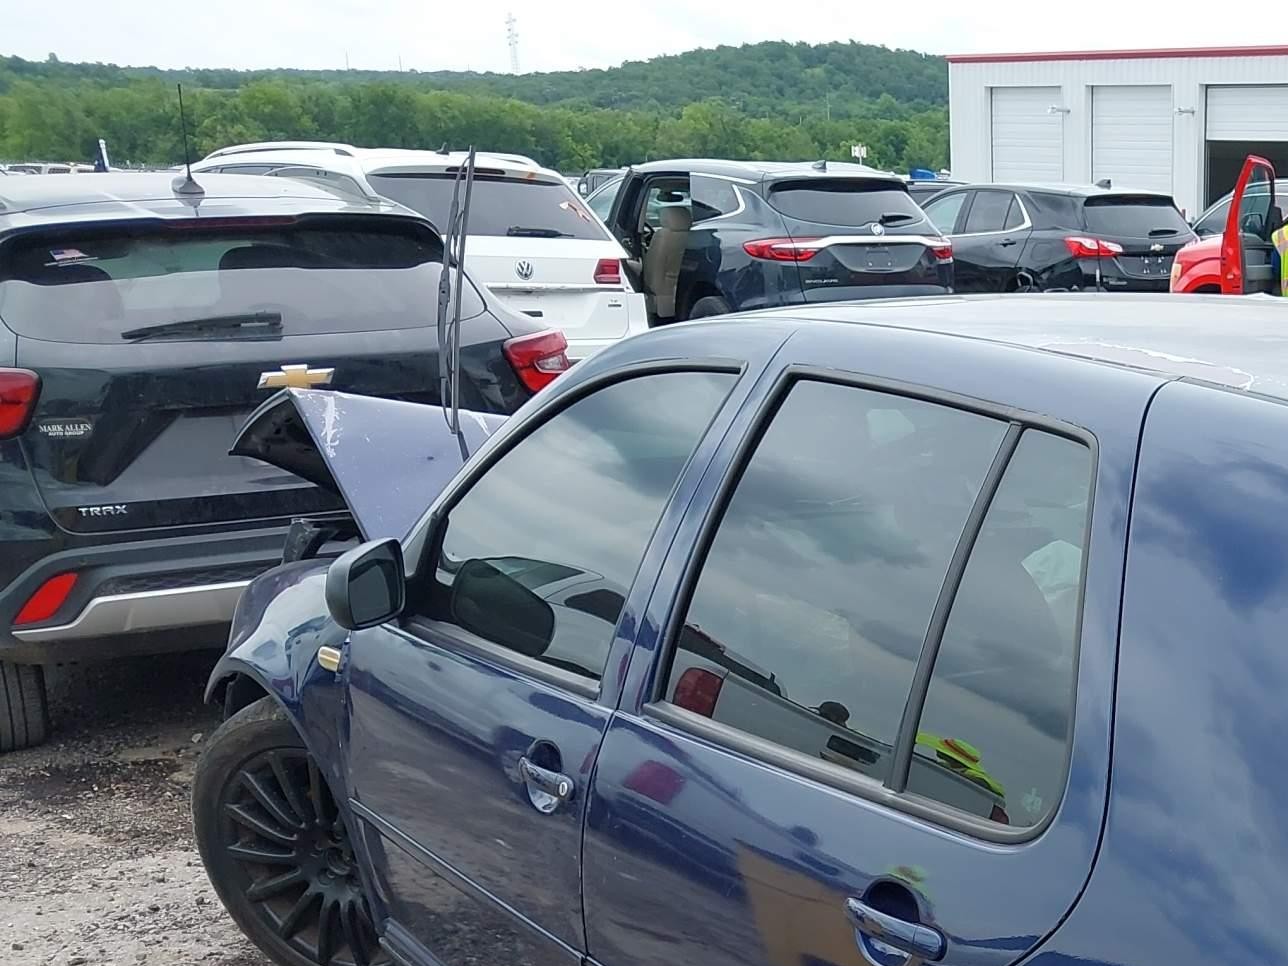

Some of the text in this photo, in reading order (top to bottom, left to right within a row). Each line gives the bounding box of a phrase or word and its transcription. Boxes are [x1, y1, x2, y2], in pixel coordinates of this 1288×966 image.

[38, 423, 92, 432] MARK ALLEN
[78, 504, 128, 517] TRAX
